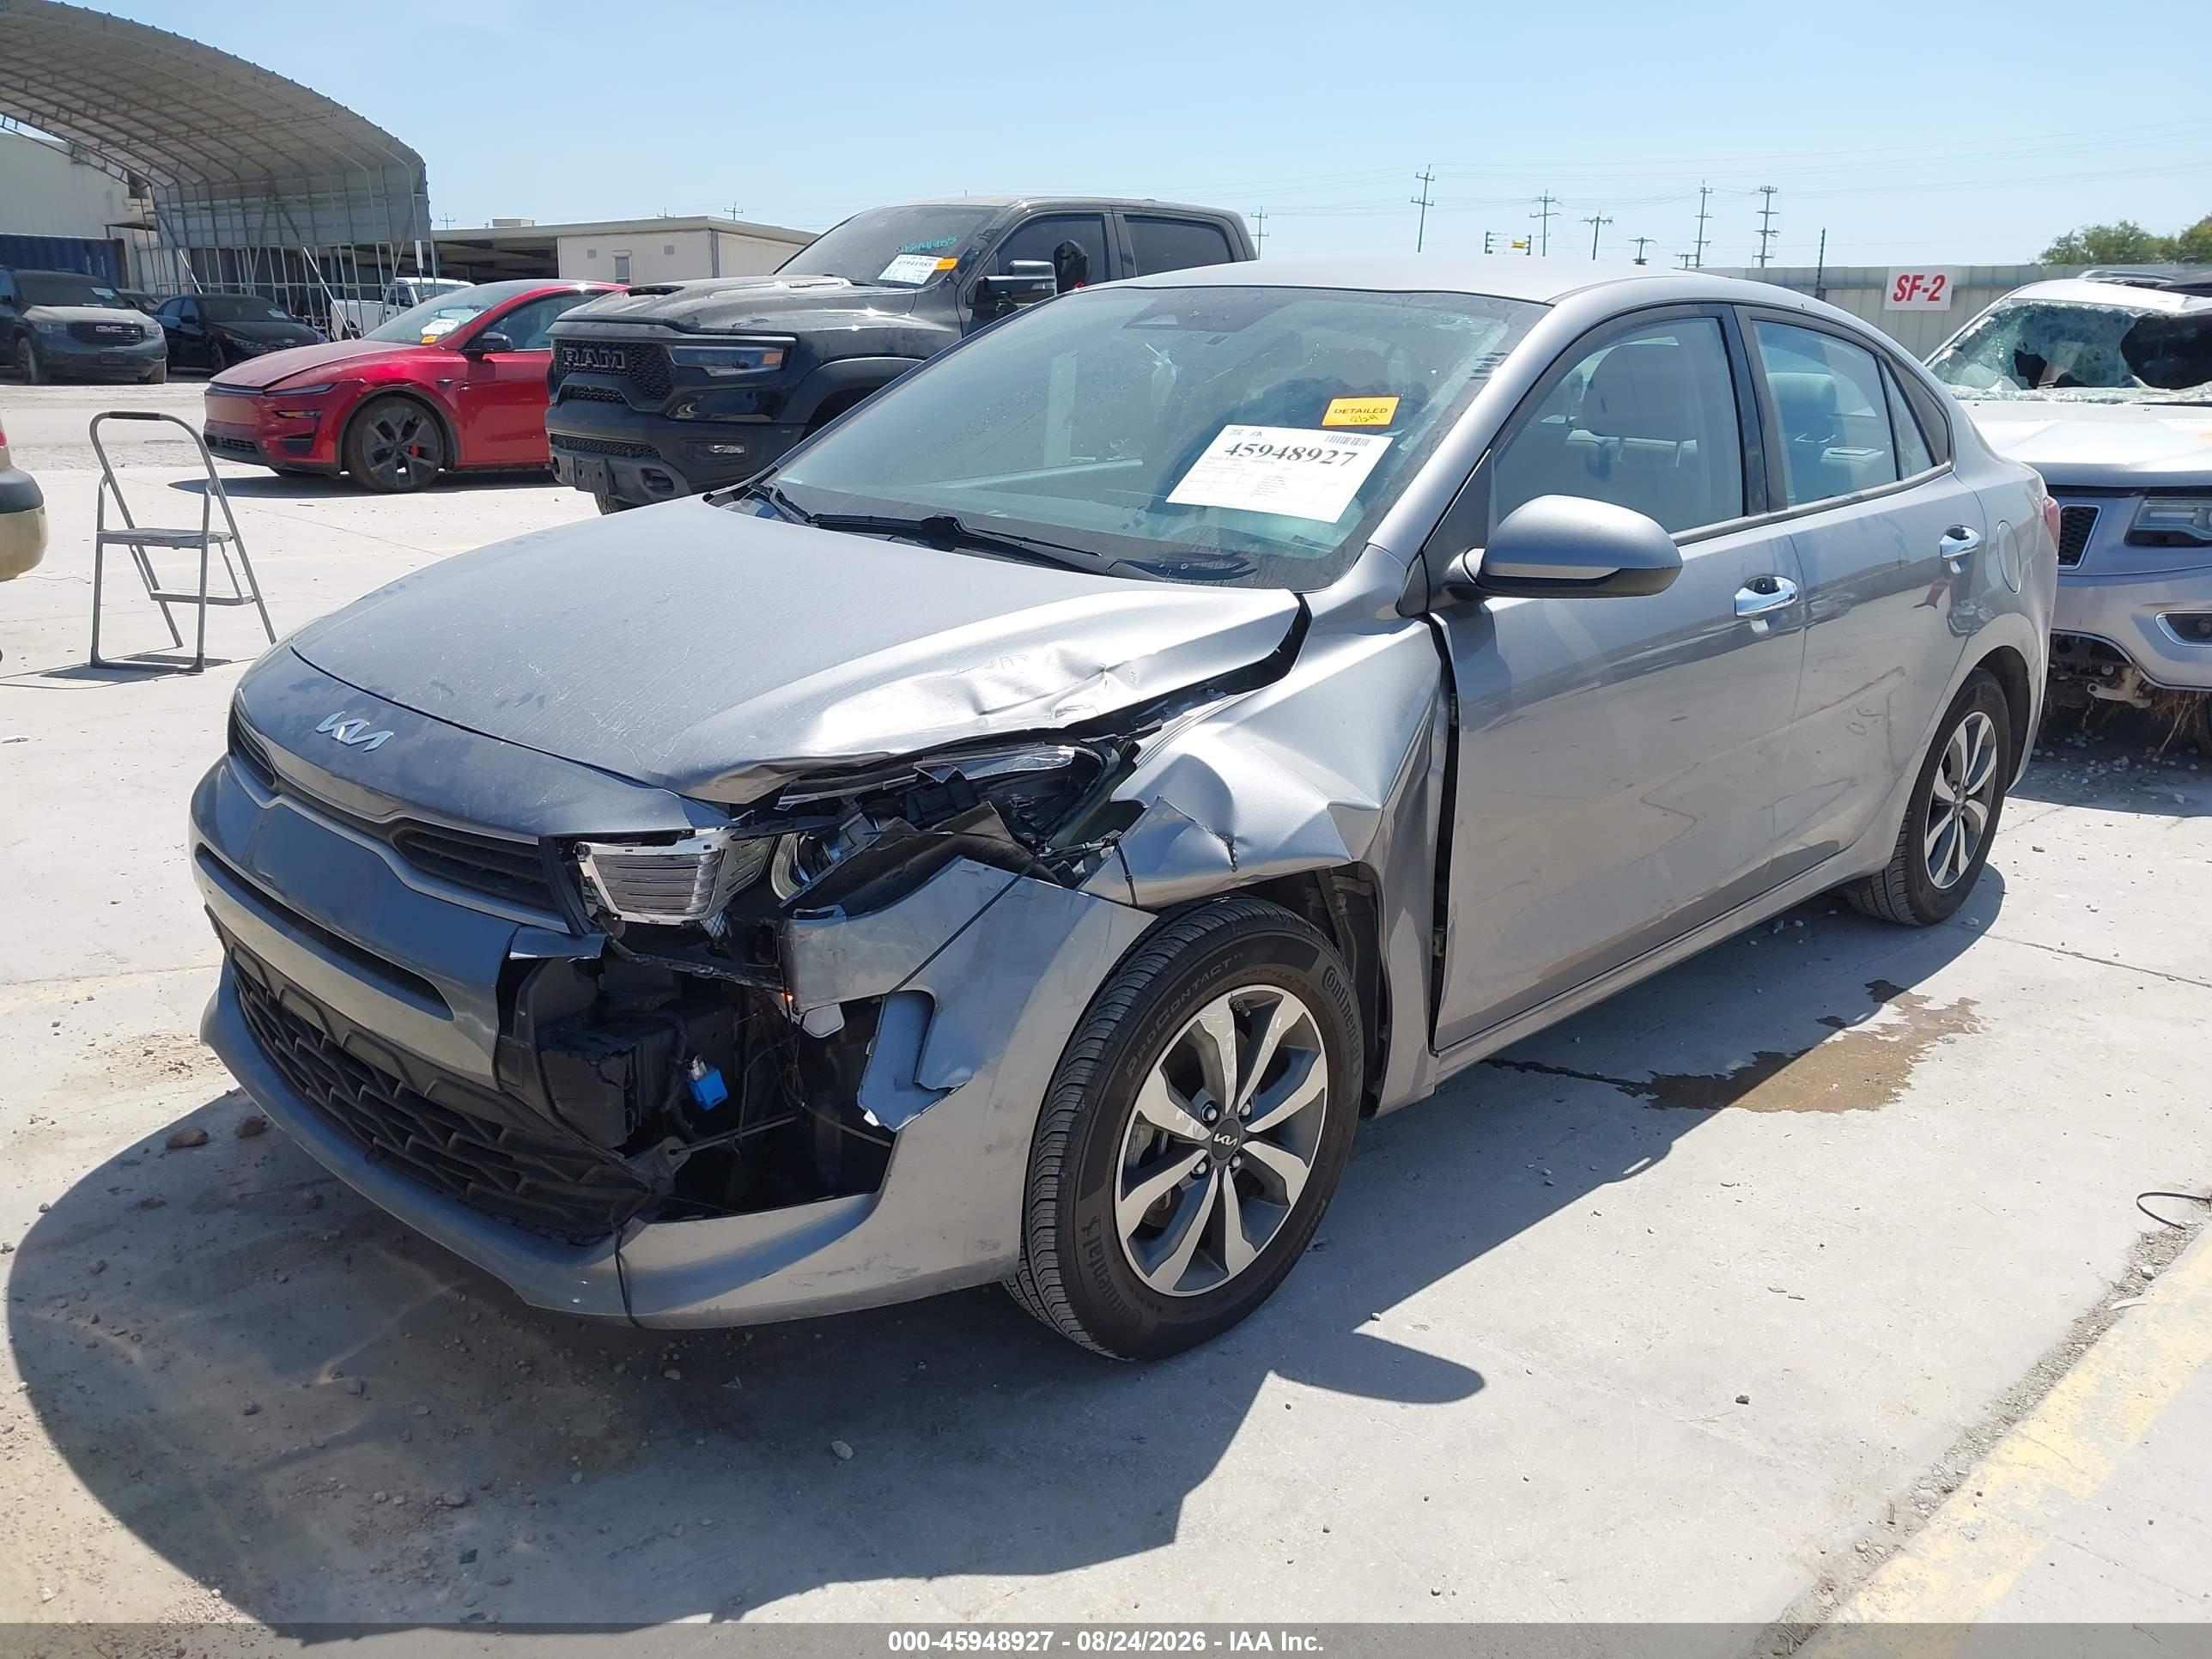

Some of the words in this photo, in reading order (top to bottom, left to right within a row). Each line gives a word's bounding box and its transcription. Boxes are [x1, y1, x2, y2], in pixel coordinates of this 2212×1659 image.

[1893, 274, 1946, 301] SF-2
[562, 347, 626, 368] RAM
[1224, 441, 1358, 467] 45948927
